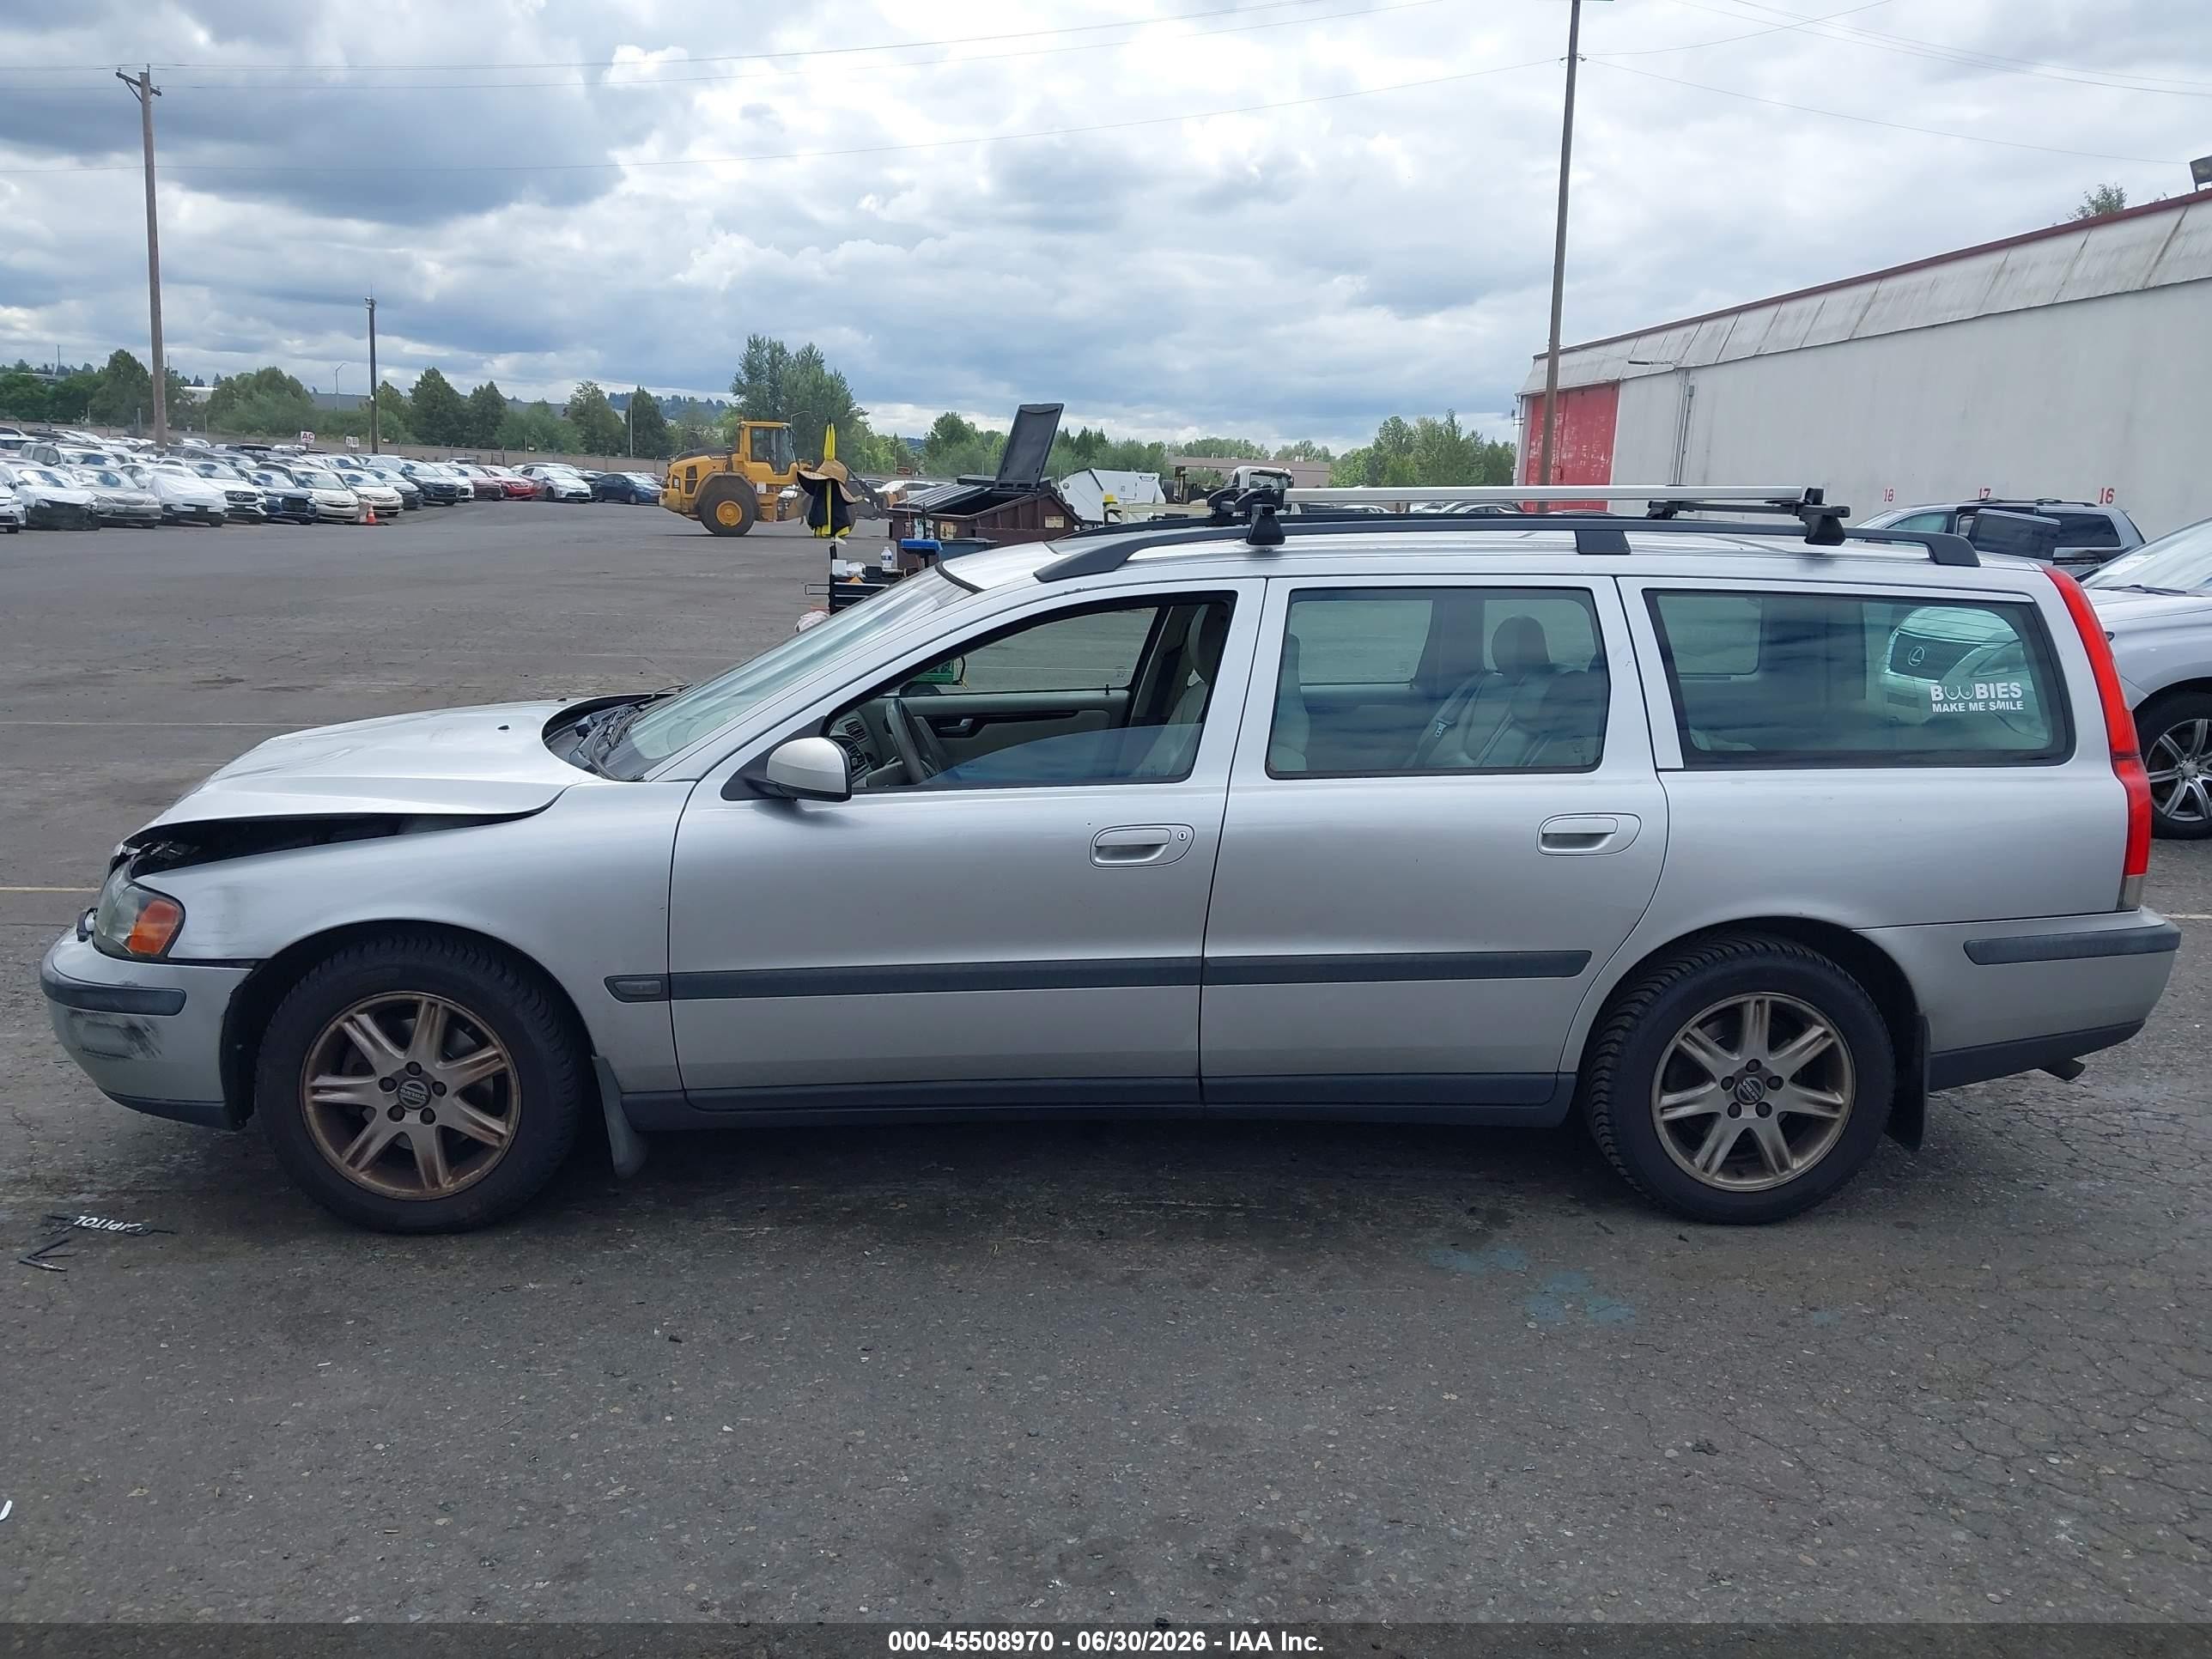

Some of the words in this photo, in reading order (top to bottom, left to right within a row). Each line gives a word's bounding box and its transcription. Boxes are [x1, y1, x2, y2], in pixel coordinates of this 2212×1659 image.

[302, 432, 314, 441] AC
[1883, 488, 1894, 502] 18
[1978, 488, 1991, 499] 17
[2100, 488, 2115, 504] 16
[1932, 702, 1966, 713] MAKE
[1968, 702, 1986, 712] ME
[1989, 700, 2025, 711] SMILE
[74, 1215, 143, 1232] CAPITOL
